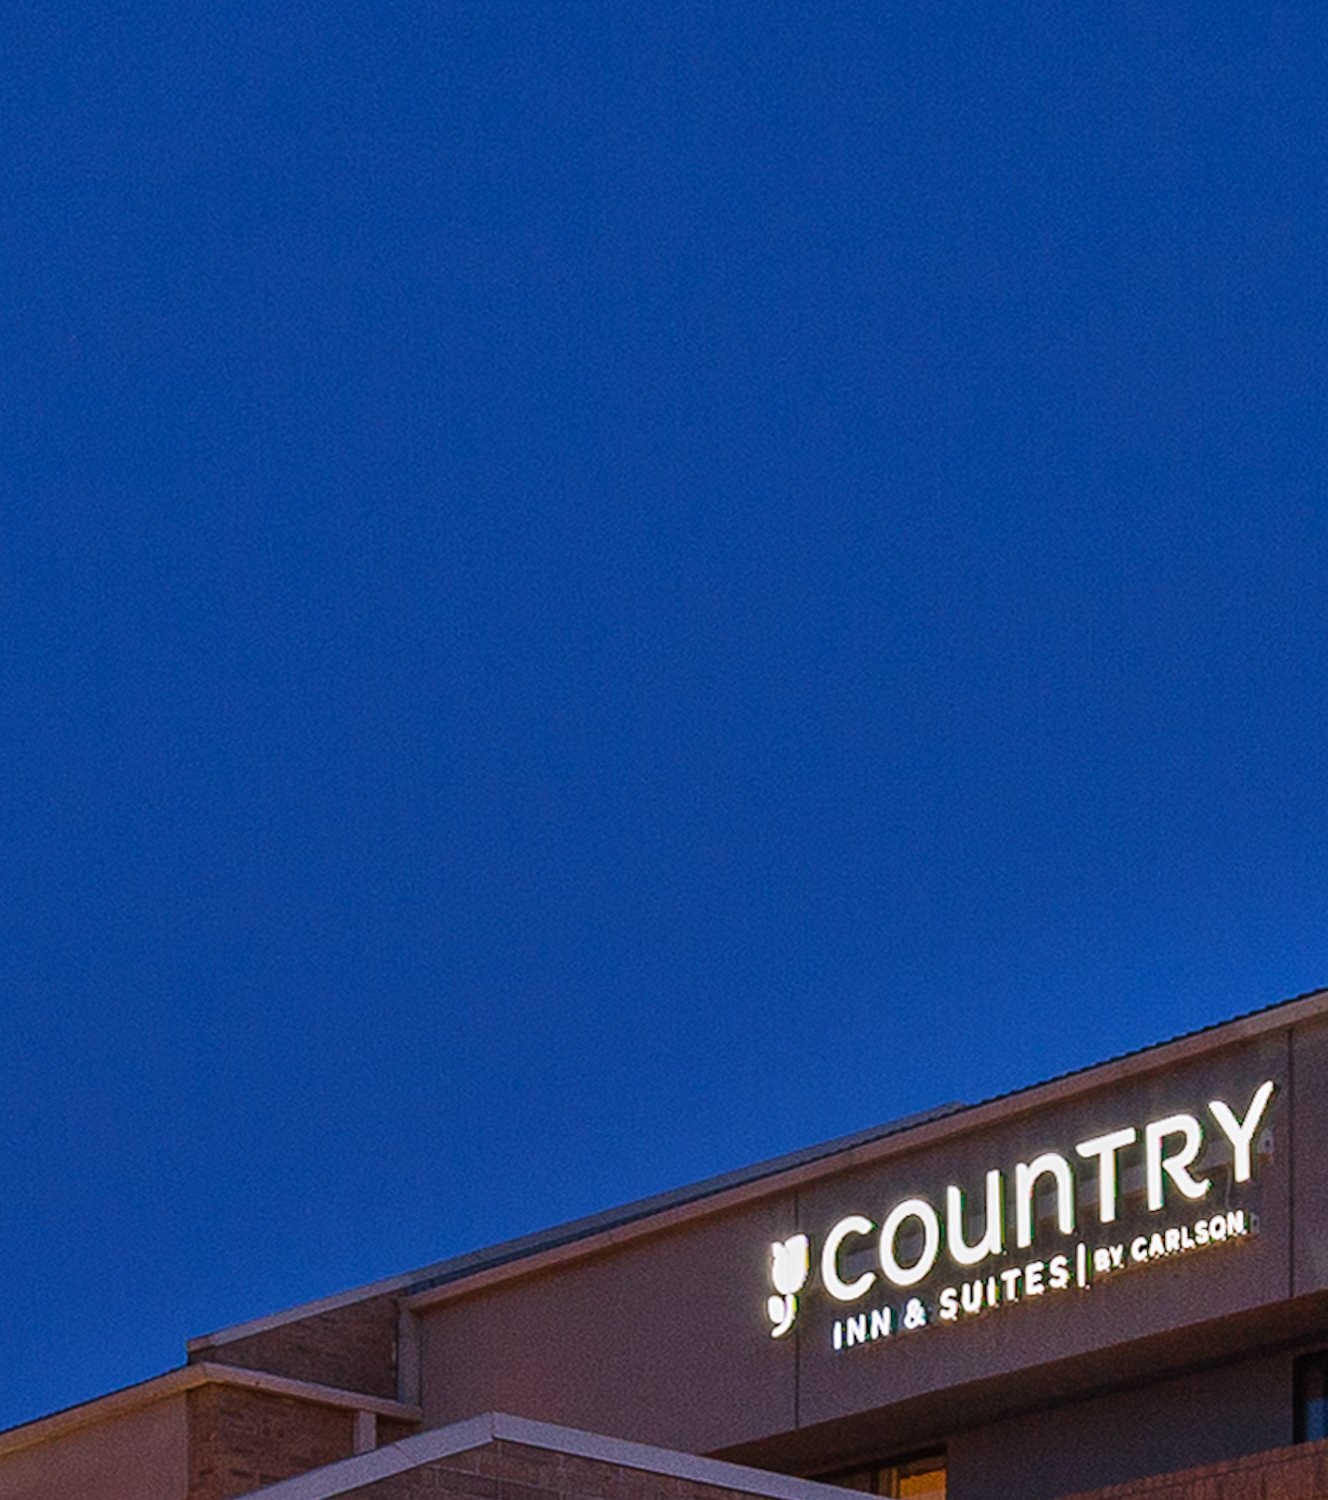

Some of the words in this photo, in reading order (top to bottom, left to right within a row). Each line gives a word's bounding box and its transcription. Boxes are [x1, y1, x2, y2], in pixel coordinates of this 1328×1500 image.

[833, 1306, 891, 1351] INN
[903, 1298, 927, 1330] &
[940, 1256, 1070, 1320] SUITES
[1094, 1245, 1123, 1272] BY
[1132, 1210, 1245, 1262] CARLSON
